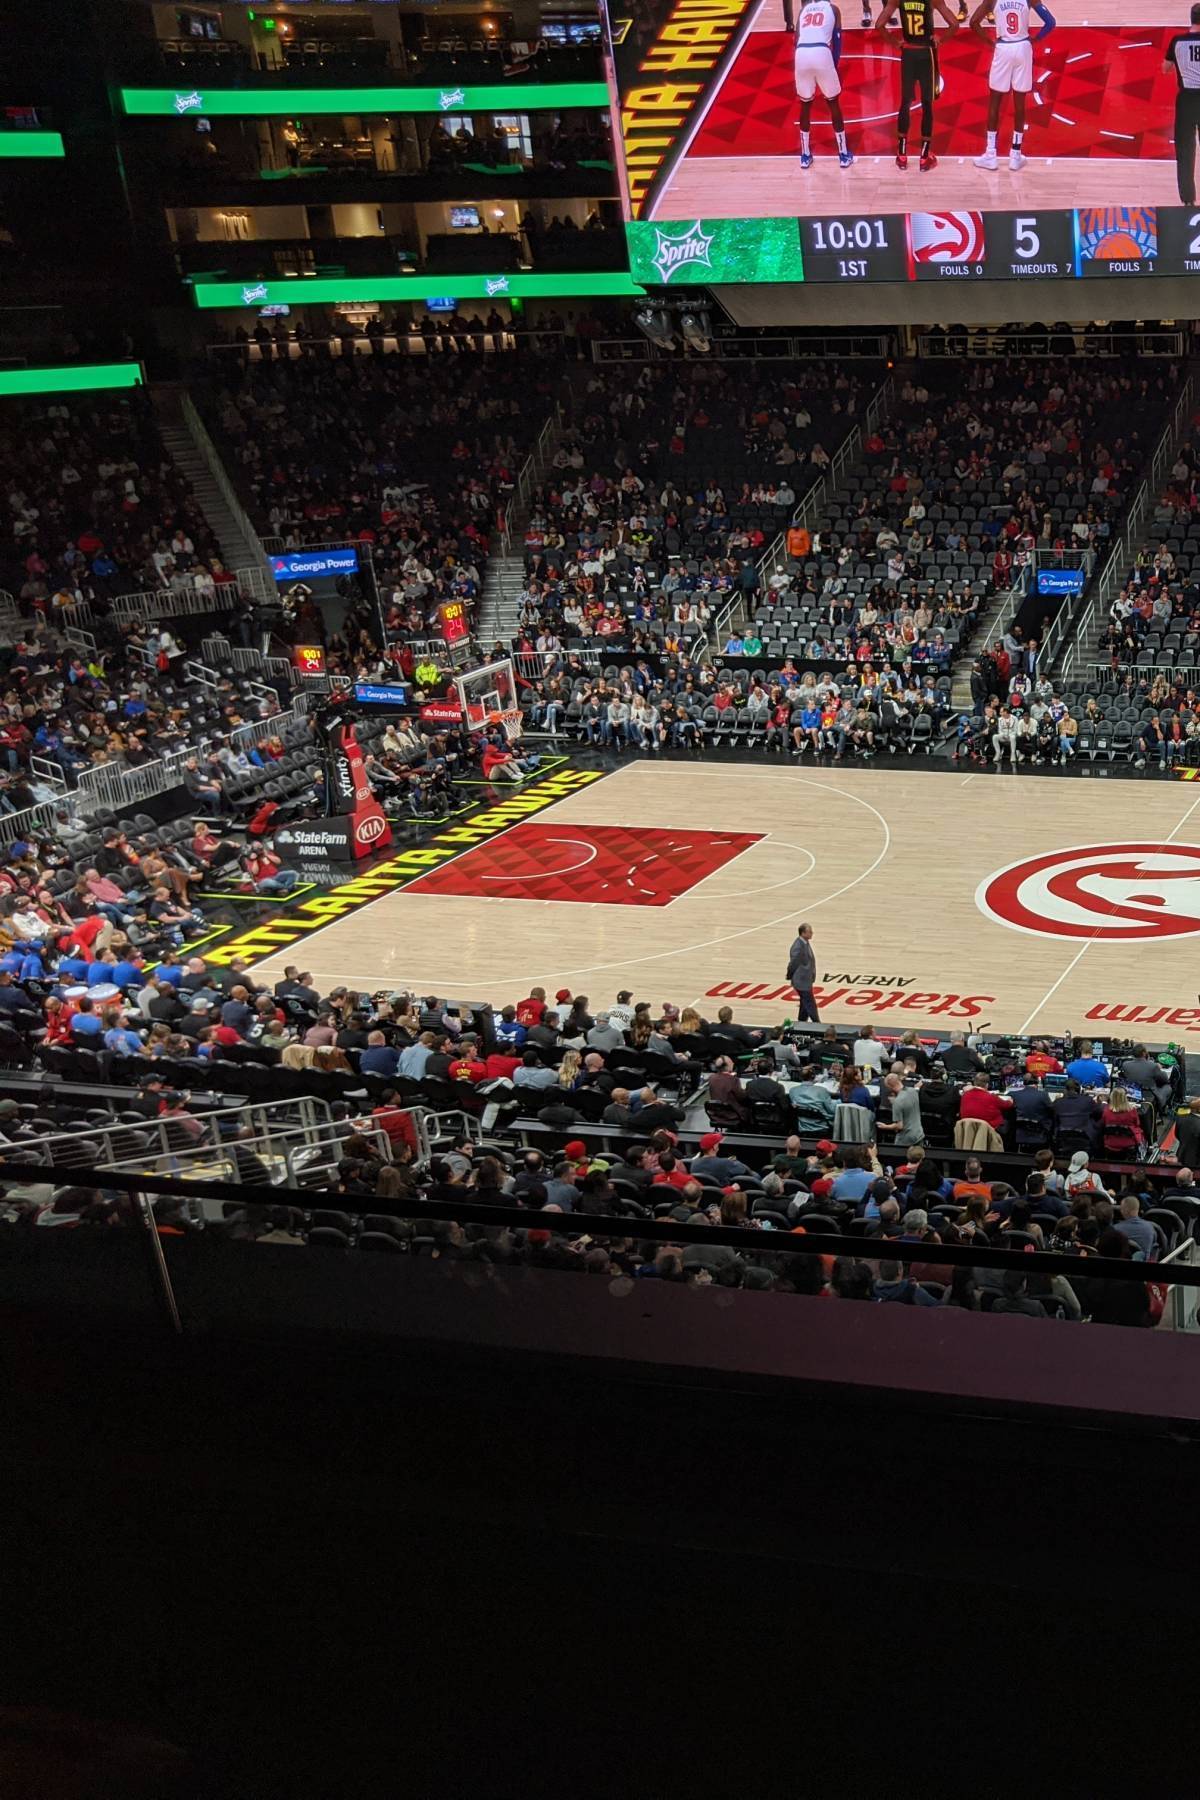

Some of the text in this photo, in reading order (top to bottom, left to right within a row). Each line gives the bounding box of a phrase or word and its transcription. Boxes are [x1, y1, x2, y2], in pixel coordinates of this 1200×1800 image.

[802, 13, 825, 28] 30
[906, 13, 925, 36] 12
[1006, 13, 1019, 35] 9
[813, 220, 888, 250] 10:01
[1015, 218, 1040, 259] 5
[659, 237, 707, 266] Sprite
[839, 260, 869, 277] 1ST
[940, 265, 983, 276] FOULS 0
[1011, 263, 1072, 274] TIMEOUTS 7
[1109, 261, 1154, 272] FOULS 1
[290, 558, 355, 573] Georgia Power
[336, 755, 355, 797] xfinity
[299, 846, 328, 856] ARENA
[201, 769, 607, 966] ATLANTA HAWKS
[822, 972, 917, 988] ARENA
